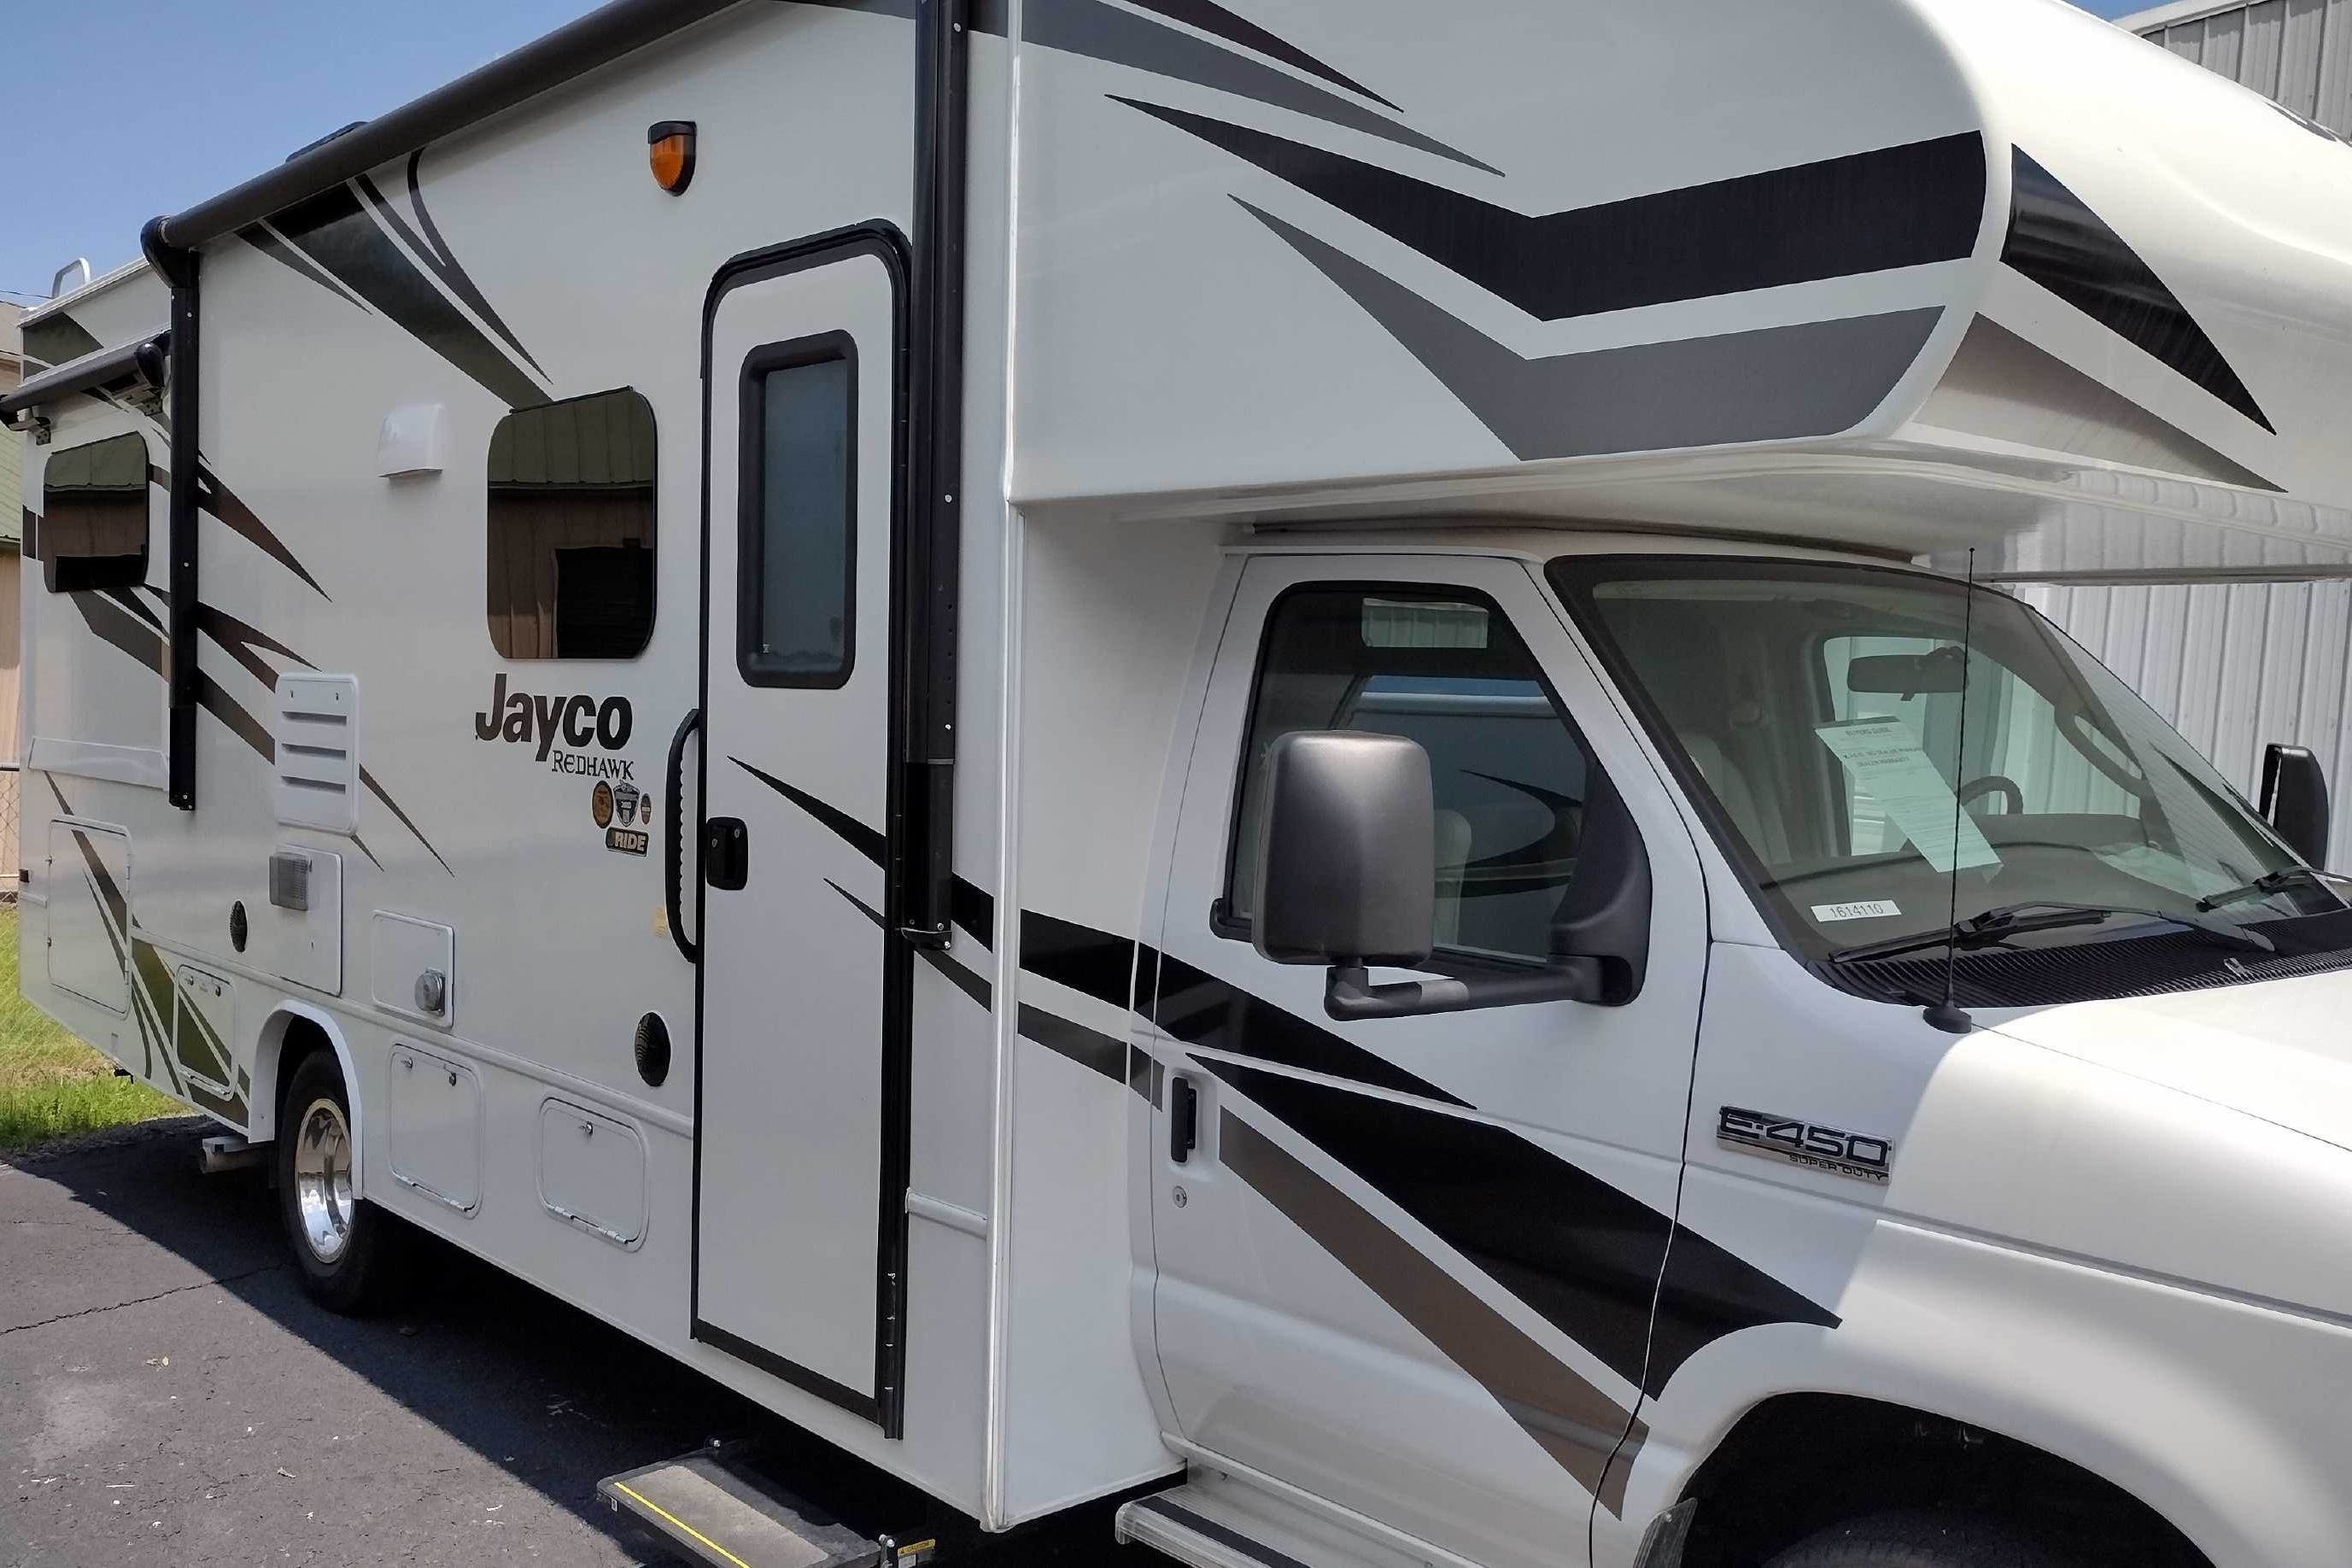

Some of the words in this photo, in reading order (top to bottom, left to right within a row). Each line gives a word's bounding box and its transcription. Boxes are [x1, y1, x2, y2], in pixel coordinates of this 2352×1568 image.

[475, 673, 633, 762] Jayco
[1830, 904, 1883, 917] 1614110
[1789, 1154, 1837, 1171] SUPER
[1842, 1167, 1889, 1181] DUTY
